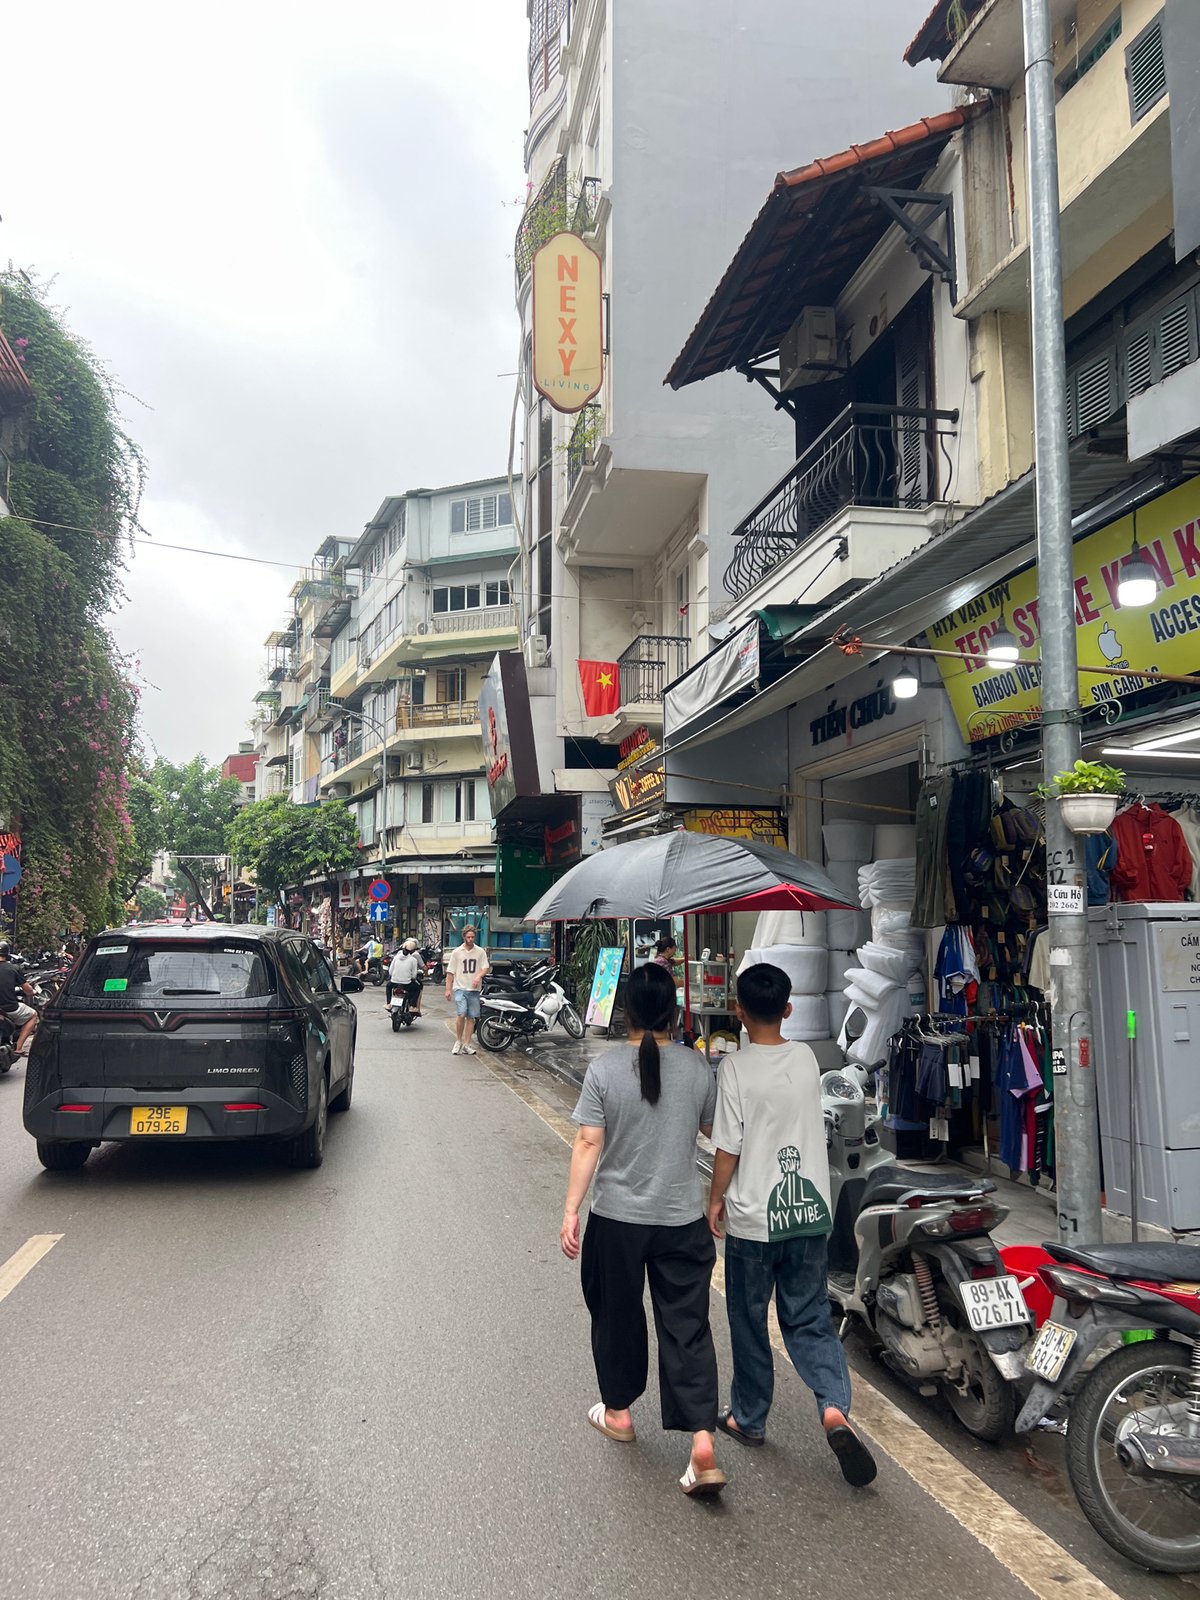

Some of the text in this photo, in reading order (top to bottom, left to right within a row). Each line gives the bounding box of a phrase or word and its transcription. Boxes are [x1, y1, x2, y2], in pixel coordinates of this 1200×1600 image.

[557, 255, 578, 376] NEXY
[544, 379, 590, 391] LIVING
[931, 616, 958, 638] HTX
[972, 671, 1018, 708] BAMBOO
[1091, 682, 1114, 702] SIM
[1113, 673, 1144, 697] CARD
[810, 680, 897, 746] TIẾN CHÚC
[462, 958, 477, 974] 10
[147, 1107, 171, 1120] 29E
[136, 1120, 180, 1132] 079.26
[776, 1172, 814, 1208] KILL
[770, 1208, 790, 1232] MY
[970, 1280, 1014, 1303] 89-AK
[971, 1301, 1026, 1326] 026.74
[1032, 1348, 1060, 1375] 8847
